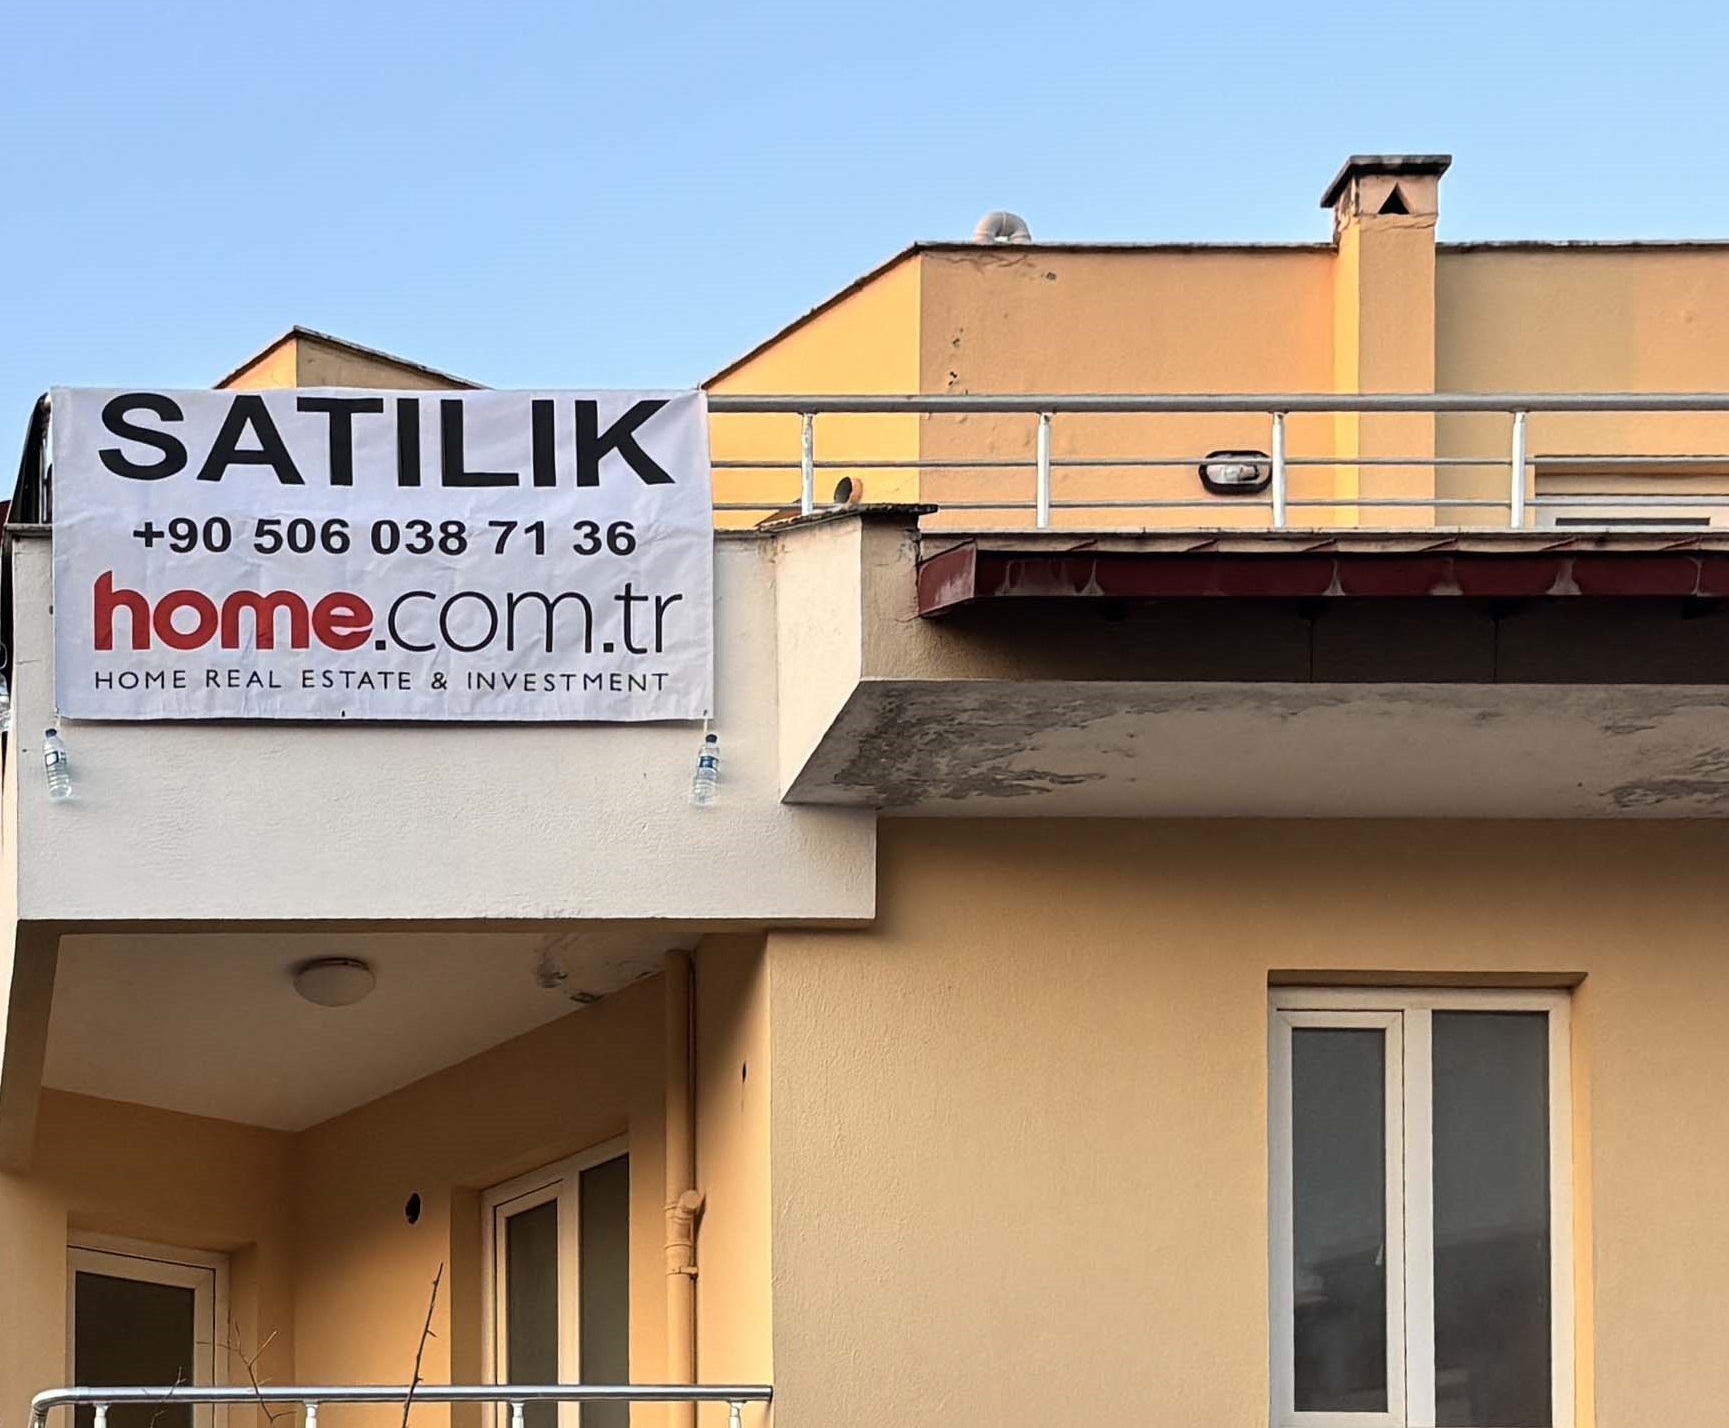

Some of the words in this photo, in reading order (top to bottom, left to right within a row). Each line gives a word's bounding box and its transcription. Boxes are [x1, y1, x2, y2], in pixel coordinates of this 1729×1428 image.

[97, 392, 676, 488] SATILIK
[132, 516, 232, 554] +90
[253, 517, 351, 555] 506
[370, 518, 468, 557] 038
[487, 520, 545, 556] 71
[572, 519, 637, 557] 36
[93, 569, 683, 655] home.com.tr
[94, 669, 187, 690] HOME
[205, 668, 282, 689] REAL
[301, 669, 411, 691] ESTATE
[430, 671, 448, 691] &
[467, 671, 669, 693] INVESTMENT
